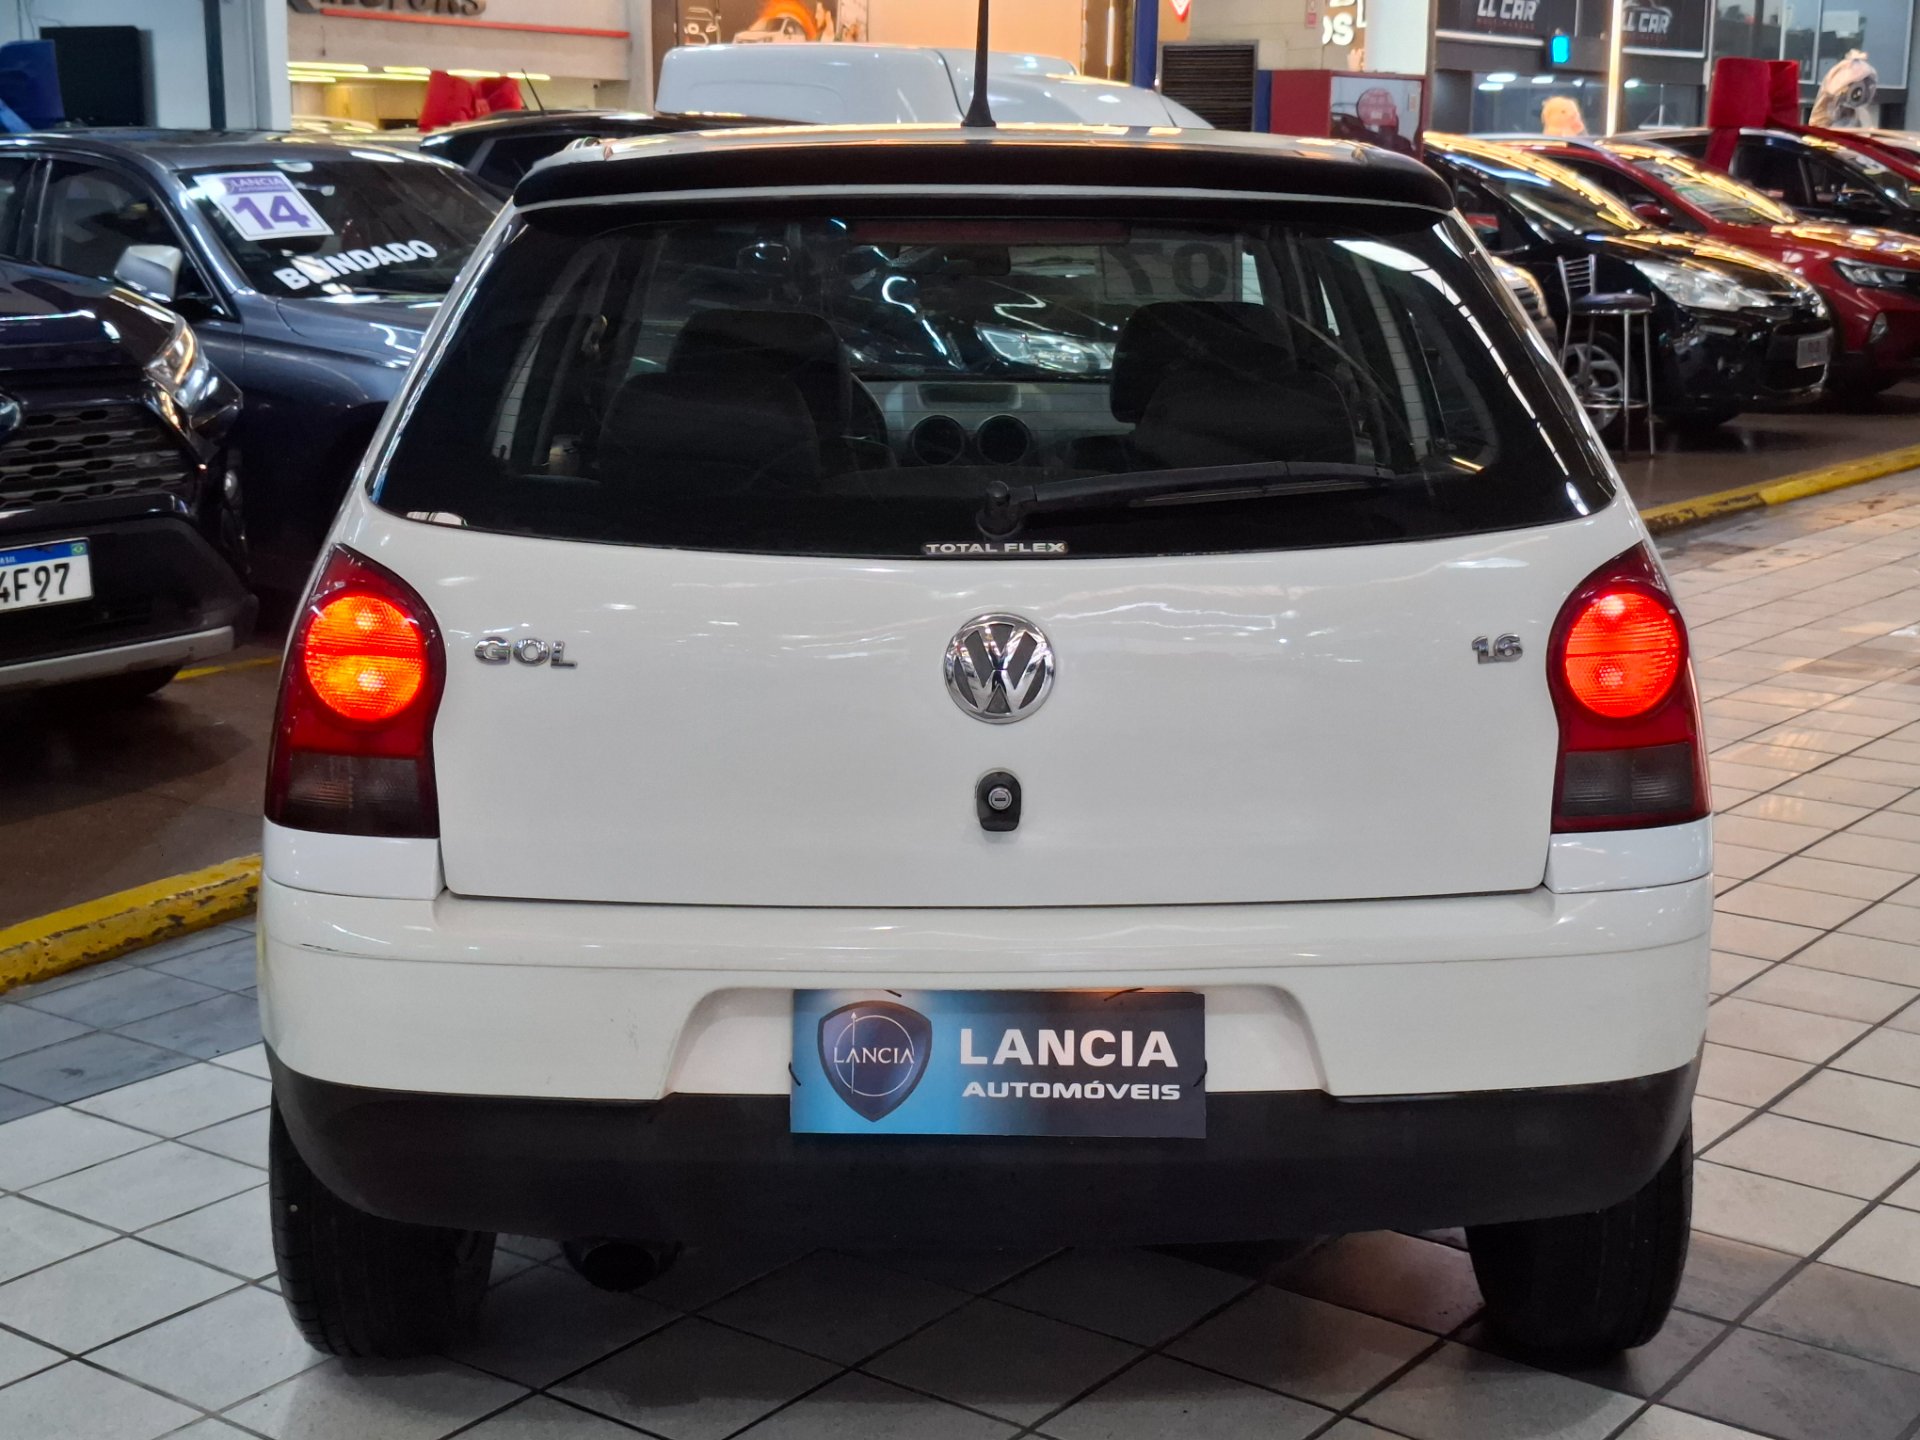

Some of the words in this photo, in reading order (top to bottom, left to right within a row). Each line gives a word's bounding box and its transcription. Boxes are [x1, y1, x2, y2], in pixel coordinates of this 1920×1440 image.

[1500, 0, 1537, 21] CAR
[1638, 12, 1670, 35] CAR
[232, 195, 311, 230] 14
[926, 544, 998, 553] TOTAL
[1004, 543, 1065, 552] FLEX
[474, 636, 577, 669] GOL
[833, 1046, 915, 1065] LANCIA
[960, 1028, 1178, 1068] LANCIA
[962, 1080, 1180, 1101] AUTOMÓVEIS
